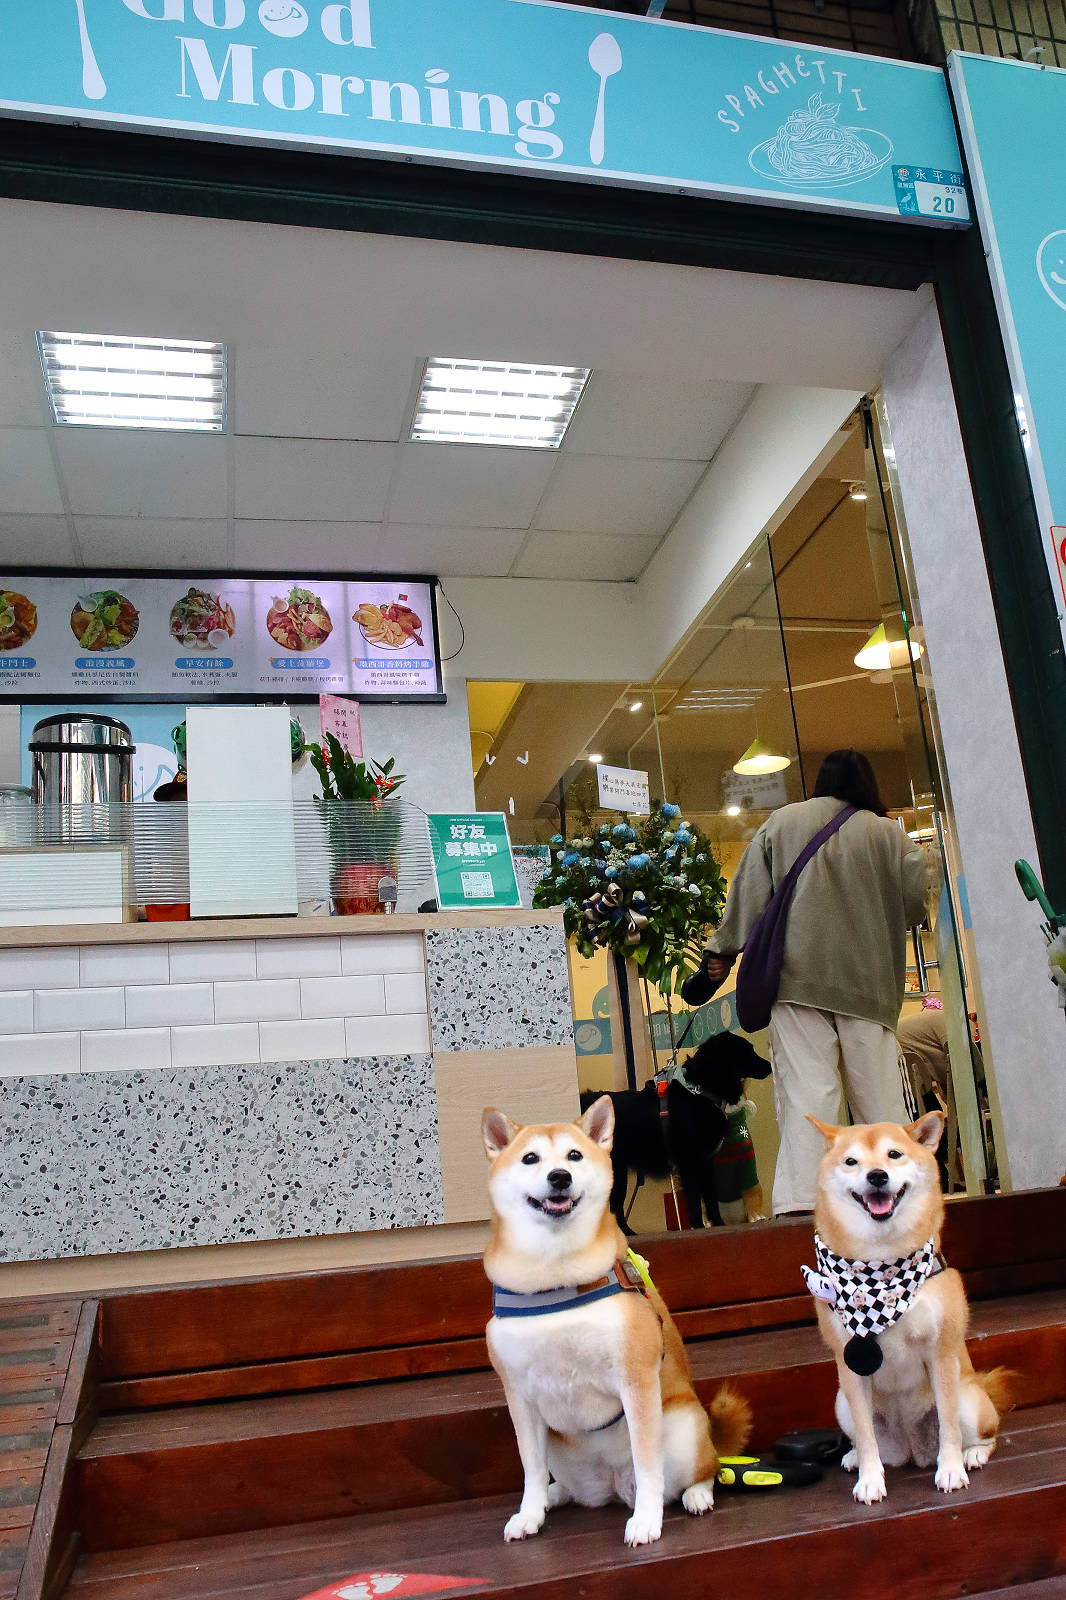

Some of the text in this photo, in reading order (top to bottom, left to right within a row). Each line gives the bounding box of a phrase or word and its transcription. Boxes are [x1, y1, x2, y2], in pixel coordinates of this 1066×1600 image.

[175, 36, 562, 160] Morning
[717, 54, 868, 133] SPAGHETTI
[932, 196, 955, 214] 20
[449, 824, 487, 839] 好友
[444, 841, 498, 857] 募集中
